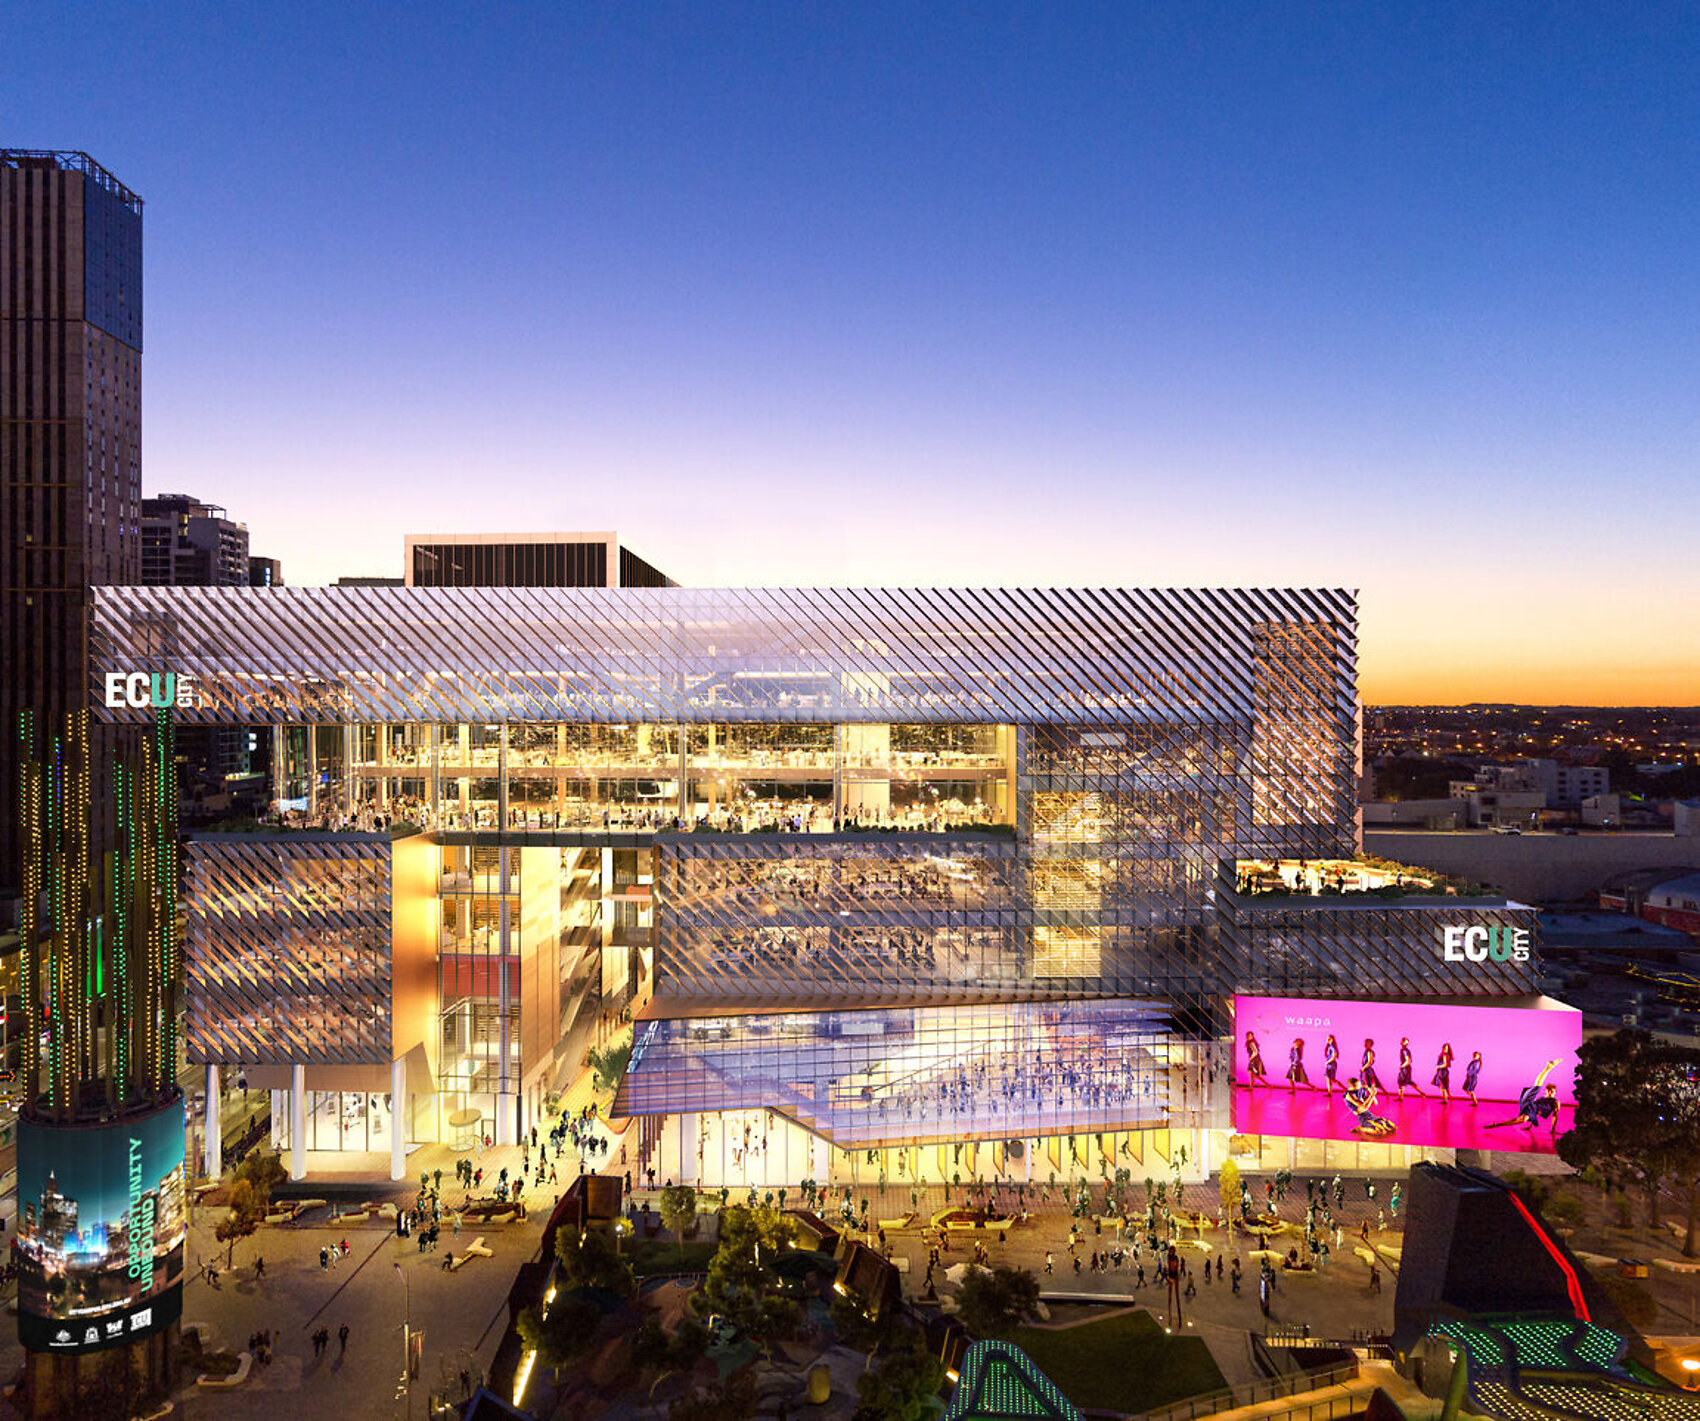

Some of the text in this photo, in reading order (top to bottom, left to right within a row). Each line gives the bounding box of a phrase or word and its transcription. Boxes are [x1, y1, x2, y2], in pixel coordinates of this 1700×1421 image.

[105, 672, 193, 707] ECU CITY
[1444, 926, 1530, 962] ECU CITY
[1285, 1016, 1331, 1027] waapa
[129, 1138, 142, 1279] OPPORTUNITY
[141, 1197, 155, 1292] UNBOUND
